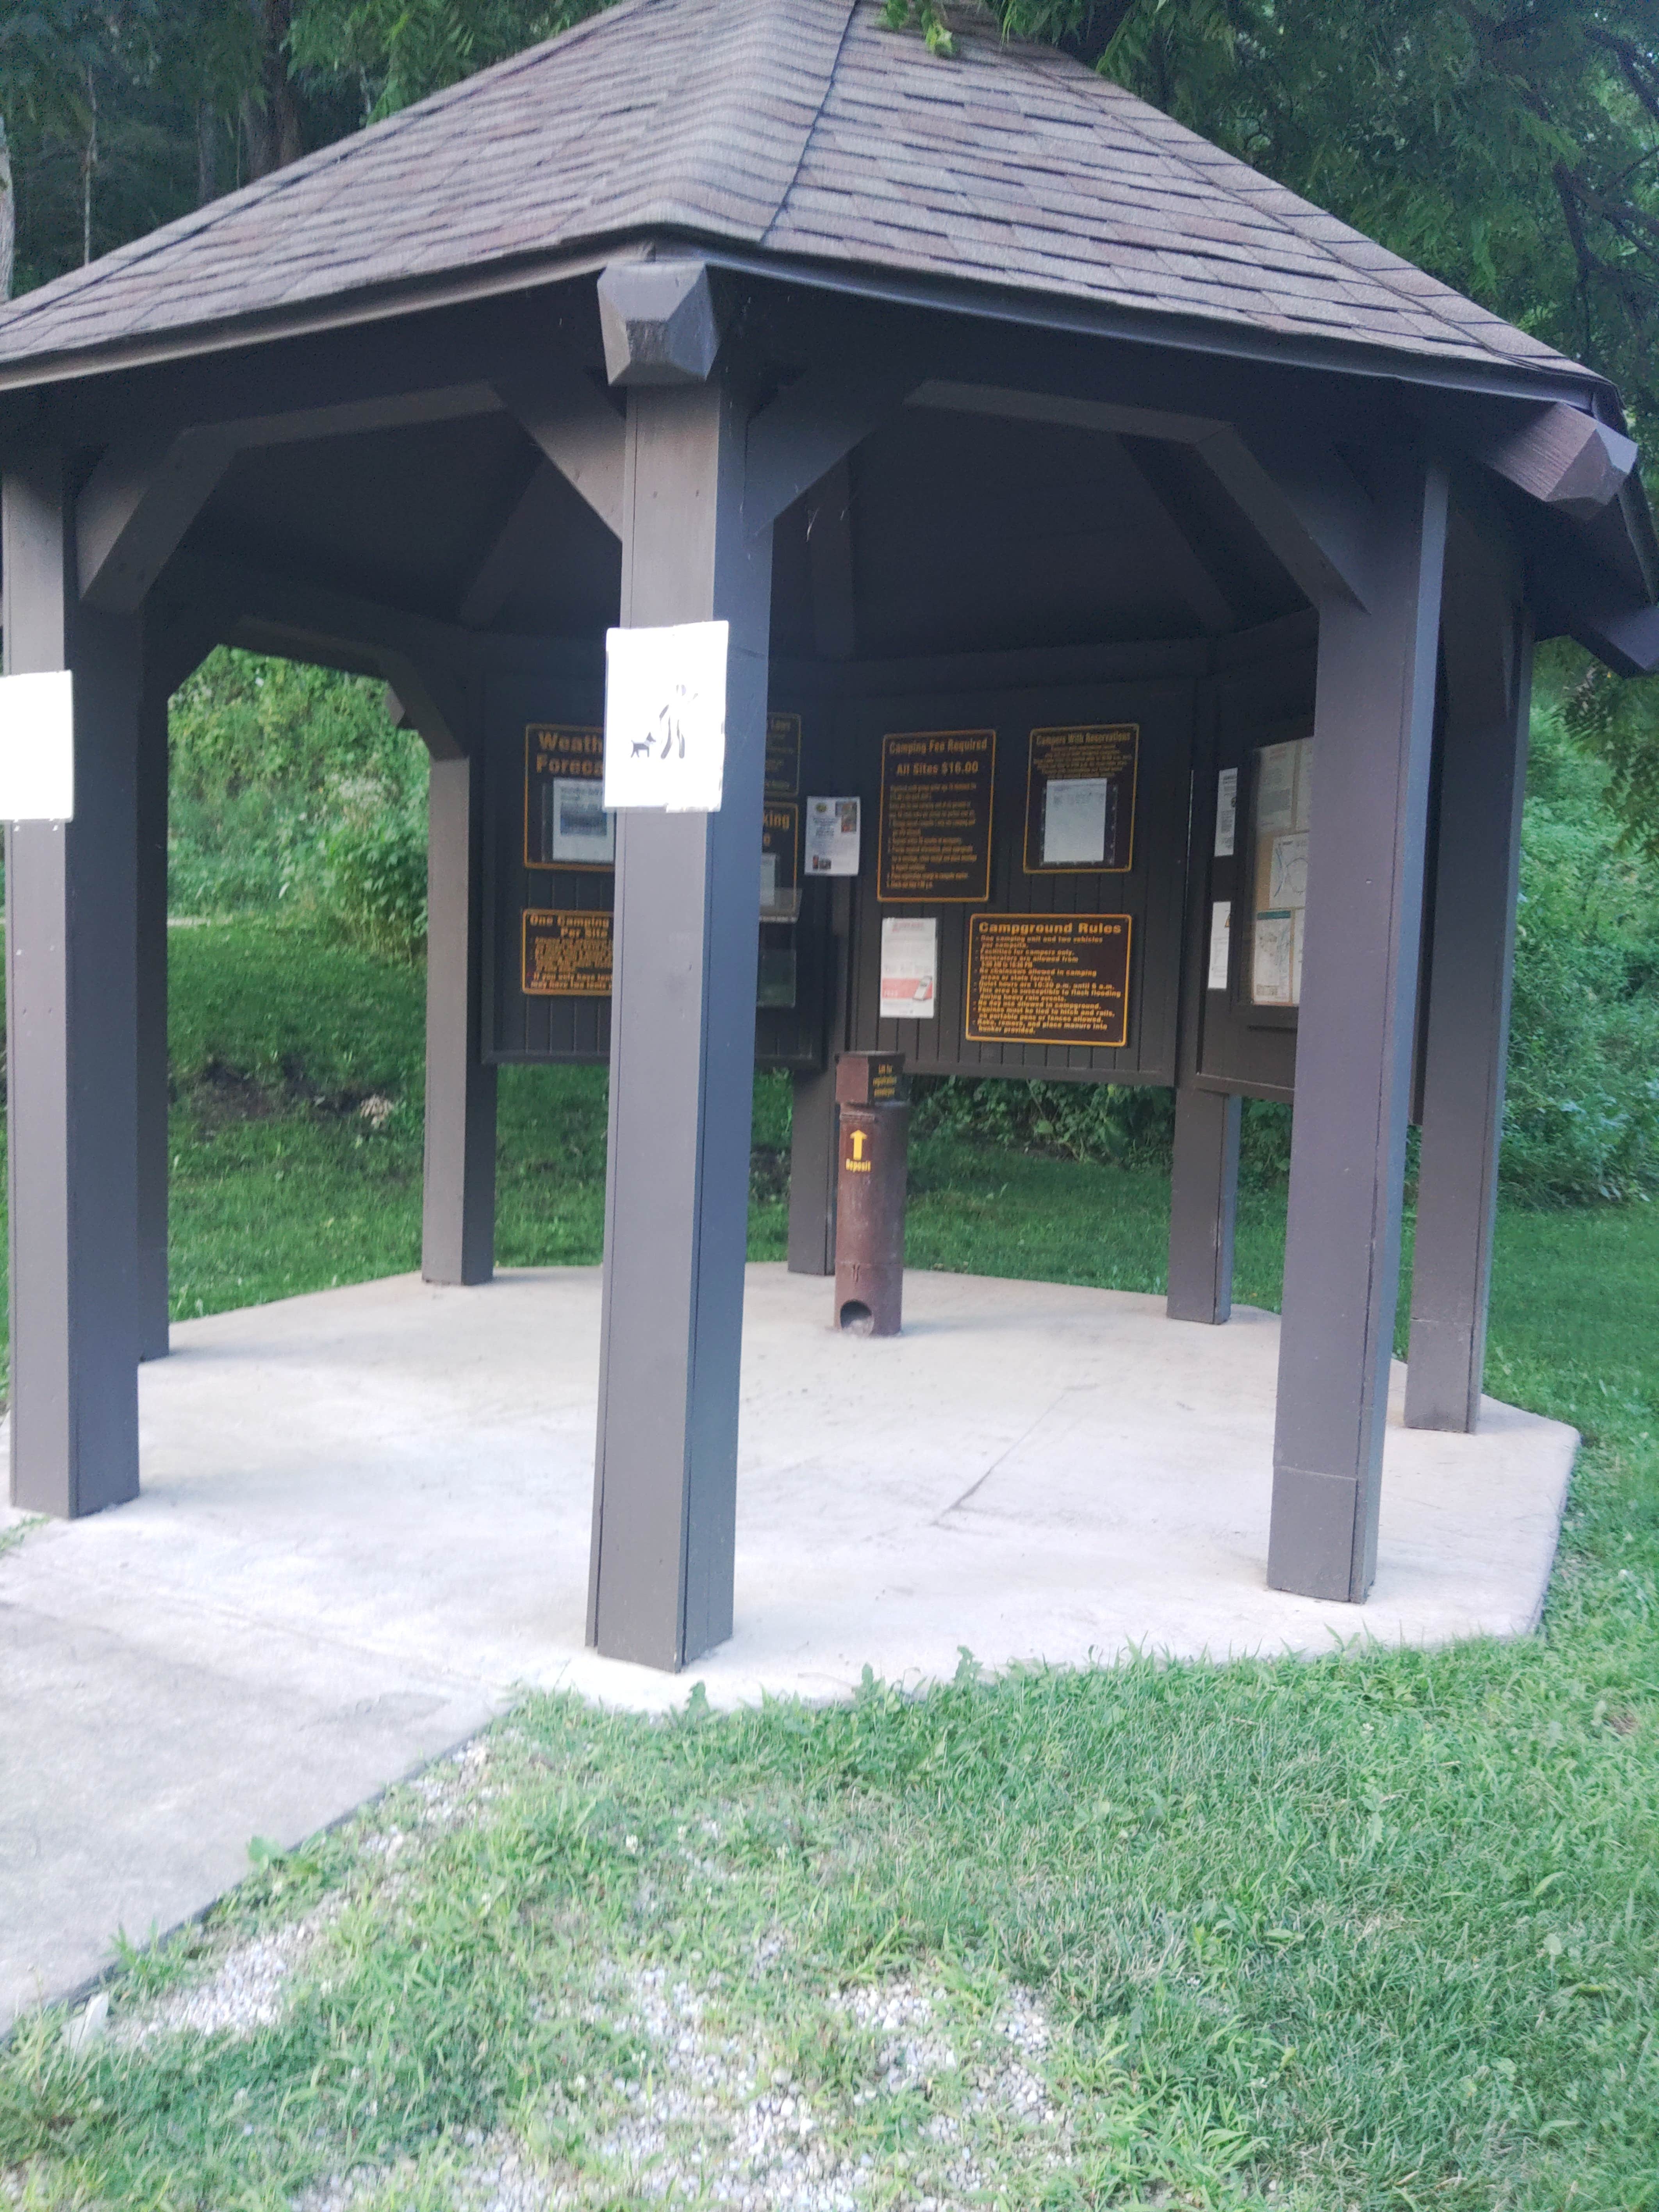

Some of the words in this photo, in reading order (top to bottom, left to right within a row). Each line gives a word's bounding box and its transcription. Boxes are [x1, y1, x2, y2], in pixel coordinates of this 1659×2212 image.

[890, 741, 926, 755] Camping
[929, 739, 945, 752] Fee
[948, 738, 987, 753] Required
[897, 763, 910, 775] All
[913, 762, 938, 775] Sites
[530, 915, 553, 926] One
[557, 915, 609, 928] Camping
[560, 927, 581, 937] Per
[585, 928, 607, 938] Site
[979, 922, 1072, 935] Campground
[1078, 922, 1122, 934] Rules
[846, 1158, 871, 1172] Deposit
